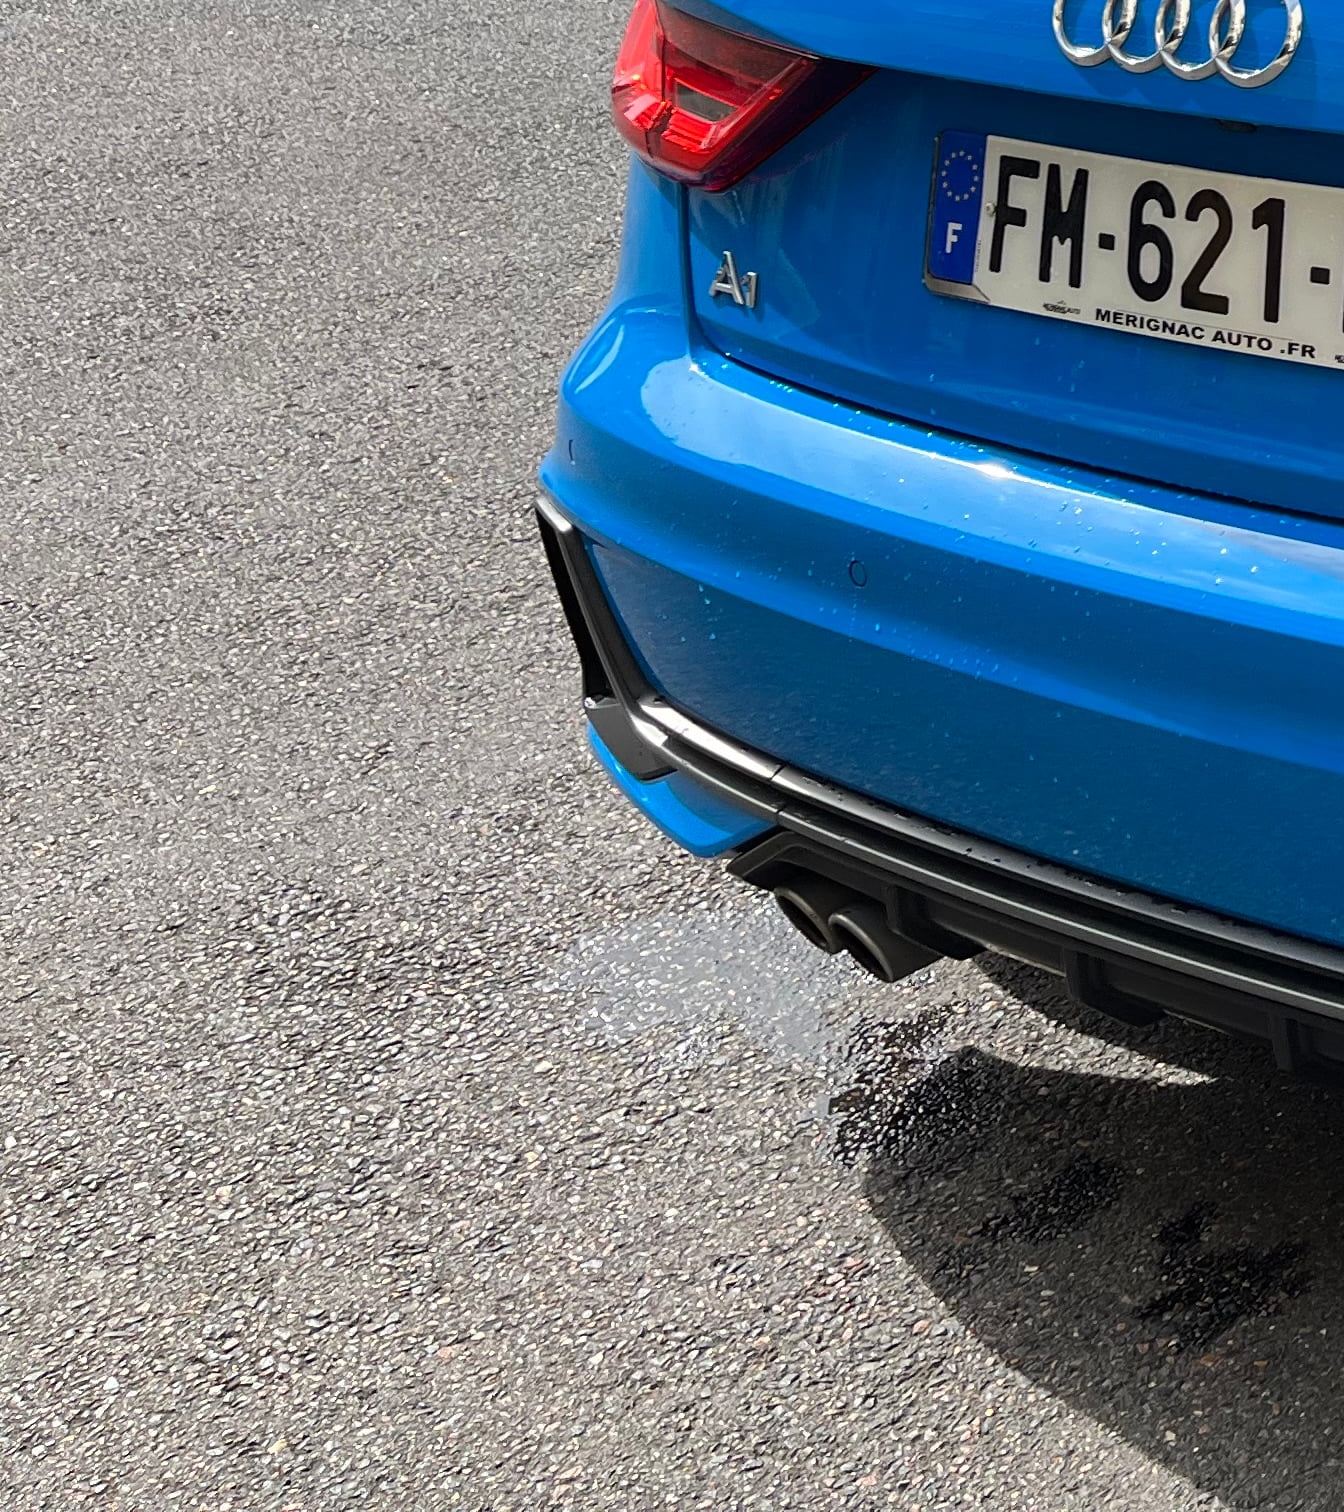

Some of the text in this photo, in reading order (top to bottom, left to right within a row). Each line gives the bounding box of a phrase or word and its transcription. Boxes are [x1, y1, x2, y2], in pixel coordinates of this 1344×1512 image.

[944, 222, 963, 255] F
[708, 250, 758, 309] A1
[1095, 308, 1205, 340] MERIGNAC
[1212, 330, 1272, 351] AUTO
